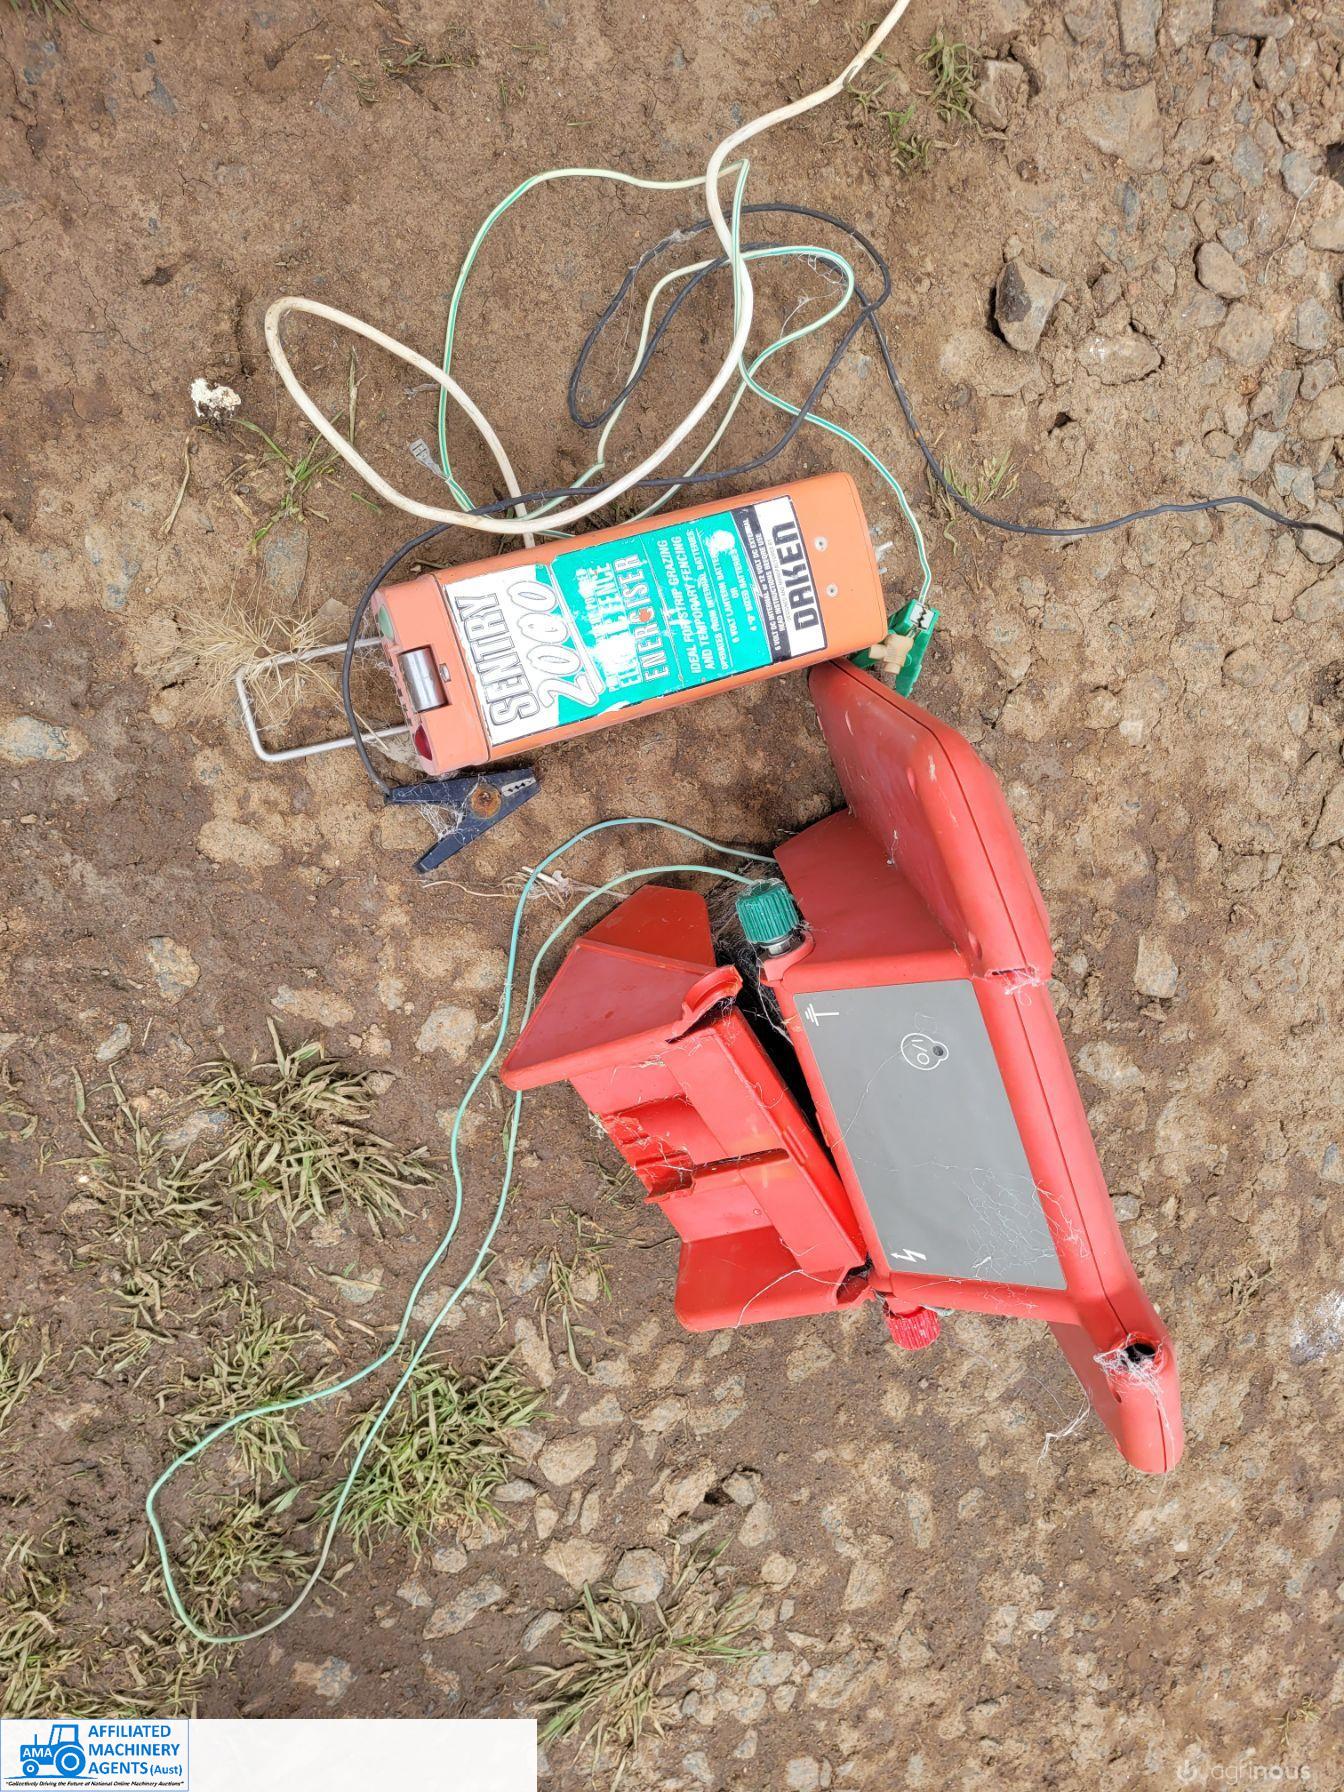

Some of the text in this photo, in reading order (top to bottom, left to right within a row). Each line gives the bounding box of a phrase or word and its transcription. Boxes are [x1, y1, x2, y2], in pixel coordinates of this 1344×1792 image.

[656, 538, 678, 586] GRAZING
[751, 548, 759, 558] DC
[753, 558, 763, 574] VOLT
[755, 532, 785, 631] READ INSTRUCTIONS BEFORE USE
[758, 574, 765, 582] 12
[771, 520, 818, 630] DAKEN
[670, 535, 715, 671] AND TEMPORARY FENCING
[670, 587, 687, 620] STRIP
[717, 581, 733, 617] LANTERN
[729, 586, 739, 598] OR
[762, 590, 774, 620] INTERNAL
[613, 554, 669, 681] ENERGISER
[727, 617, 738, 636] VOLT
[769, 620, 776, 630] DC
[506, 580, 597, 708] 2000
[771, 630, 780, 645] VOLT
[454, 592, 540, 726] SENTRY
[685, 644, 702, 674] IDEAL
